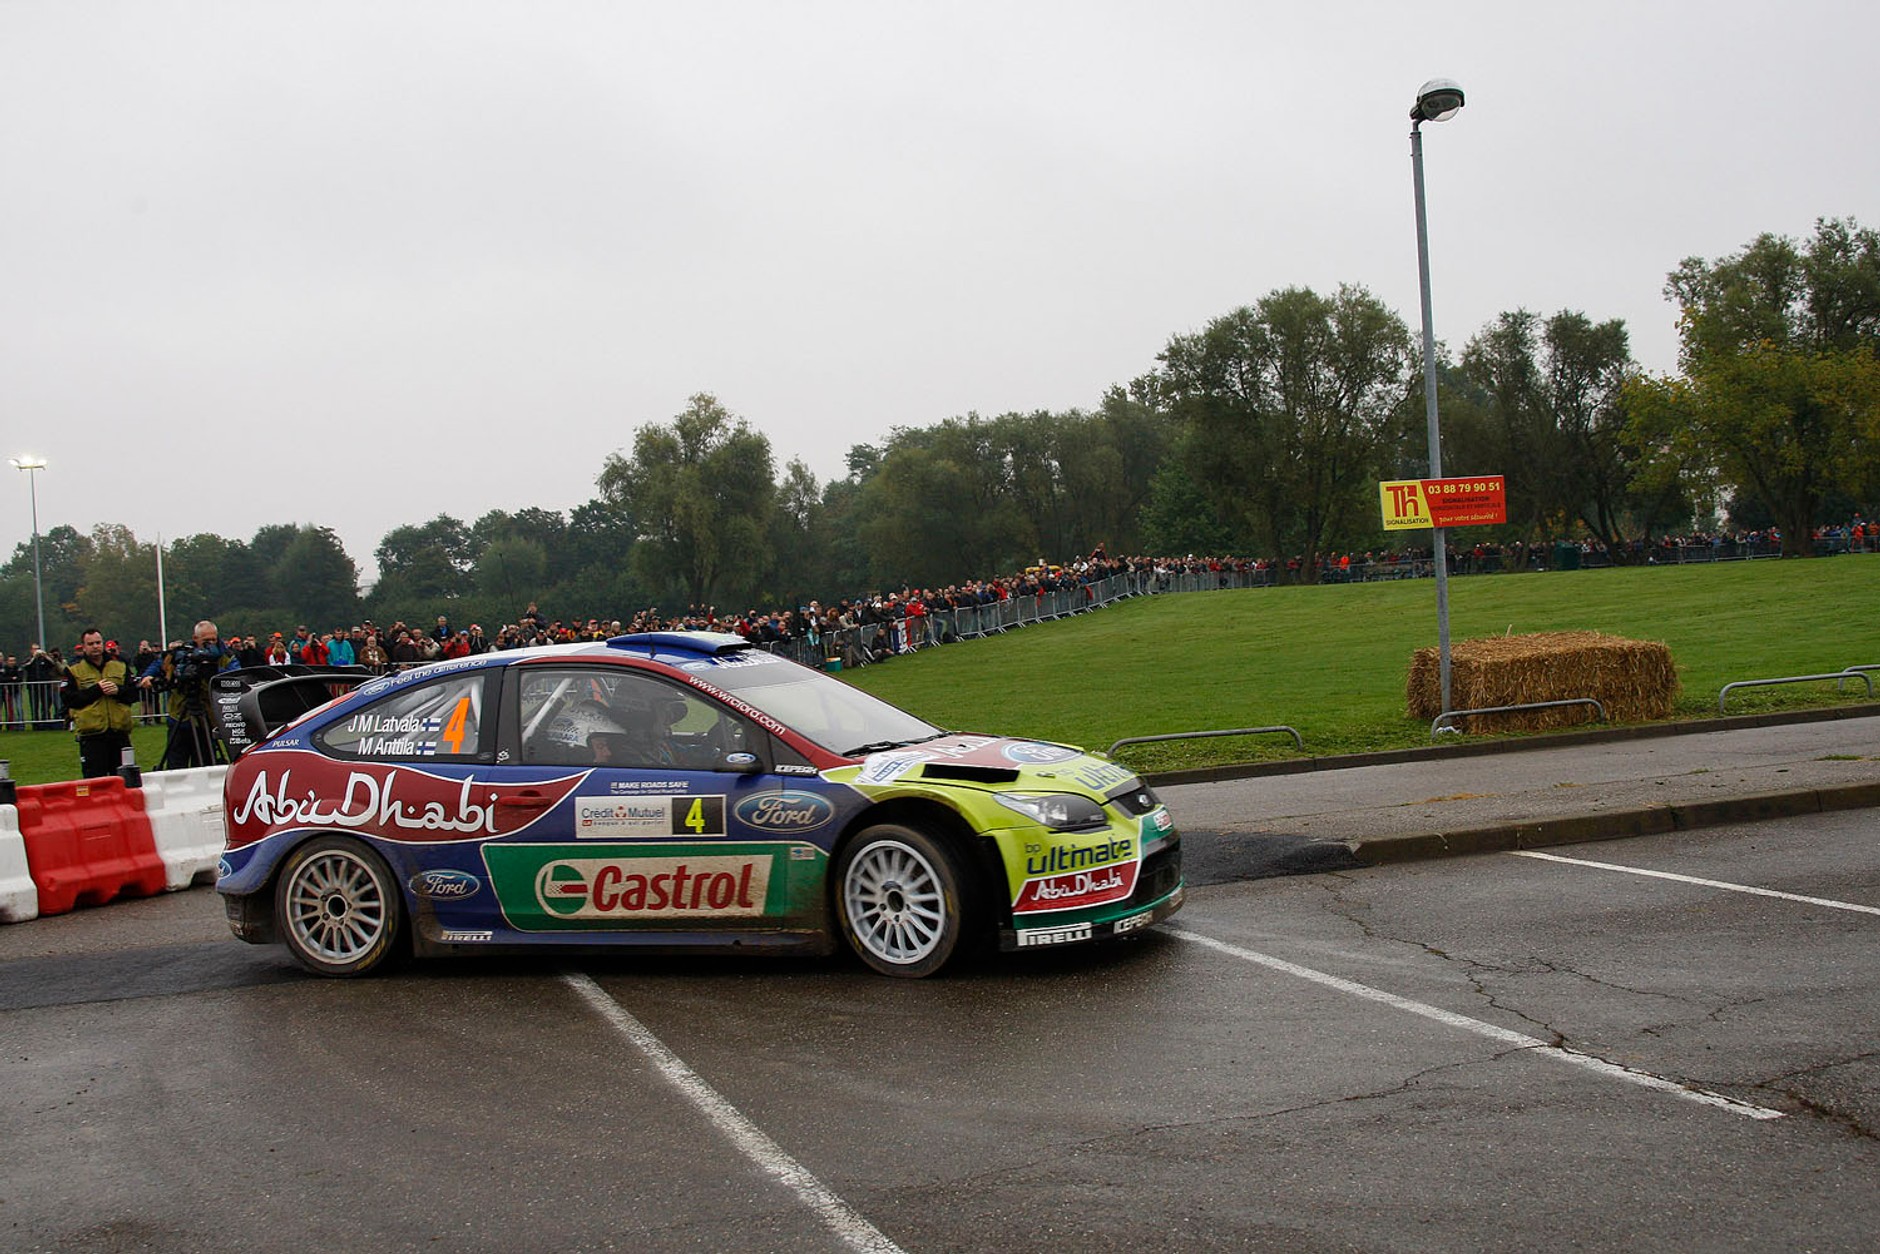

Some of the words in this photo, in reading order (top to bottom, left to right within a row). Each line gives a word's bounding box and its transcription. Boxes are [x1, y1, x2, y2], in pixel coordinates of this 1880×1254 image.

[1428, 485, 1441, 495] 03
[1443, 484, 1456, 494] 88
[1459, 483, 1471, 493] 79
[1473, 482, 1486, 492] 90
[1489, 482, 1500, 491] 51
[1386, 517, 1429, 526] SIGNALISATION
[390, 674, 412, 687] Feel
[414, 669, 432, 679] the
[434, 659, 487, 674] difference
[689, 676, 786, 735] www.wrcford.com
[348, 715, 358, 733] J
[358, 715, 373, 732] M
[374, 715, 420, 732] Latvala
[442, 697, 470, 754] 4
[272, 739, 300, 748] PULSAR
[358, 737, 373, 755] M
[373, 737, 415, 755] Anttila
[618, 781, 640, 789] MAKE
[668, 780, 689, 788] SAFE
[233, 769, 336, 827] Abu
[338, 769, 499, 833] Dhabi
[628, 806, 665, 818] Mutuel
[751, 792, 816, 826] Ford
[684, 798, 706, 834] 4
[1027, 837, 1133, 875] ultimate
[426, 873, 468, 895] Ford
[592, 863, 753, 913] Castrol
[1030, 879, 1071, 901] Abu
[1072, 868, 1125, 896] Dhabi
[1017, 922, 1092, 946] PIRELLI
